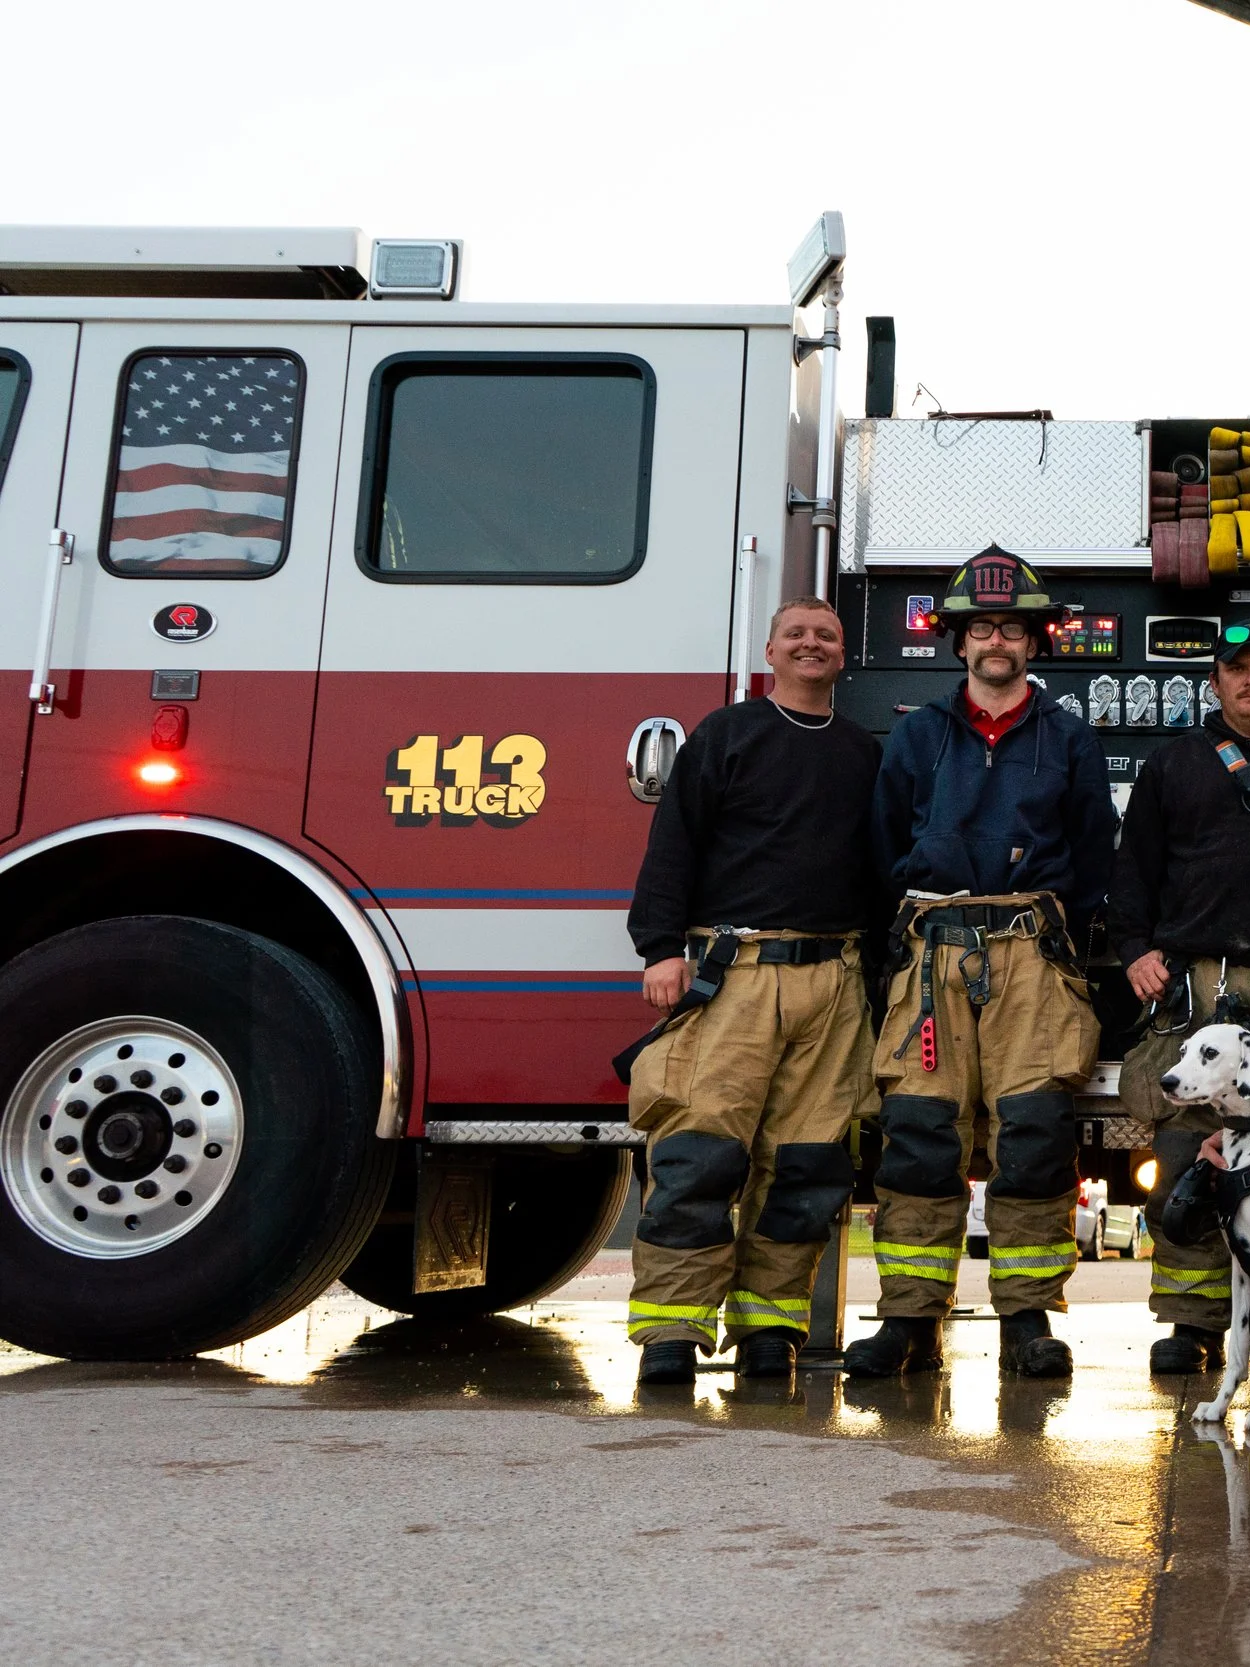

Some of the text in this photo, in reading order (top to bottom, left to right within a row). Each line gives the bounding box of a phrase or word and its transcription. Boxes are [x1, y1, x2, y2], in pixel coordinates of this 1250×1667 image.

[974, 567, 1014, 593] 1115
[397, 734, 547, 818] 113
[384, 785, 541, 815] TRUCK
